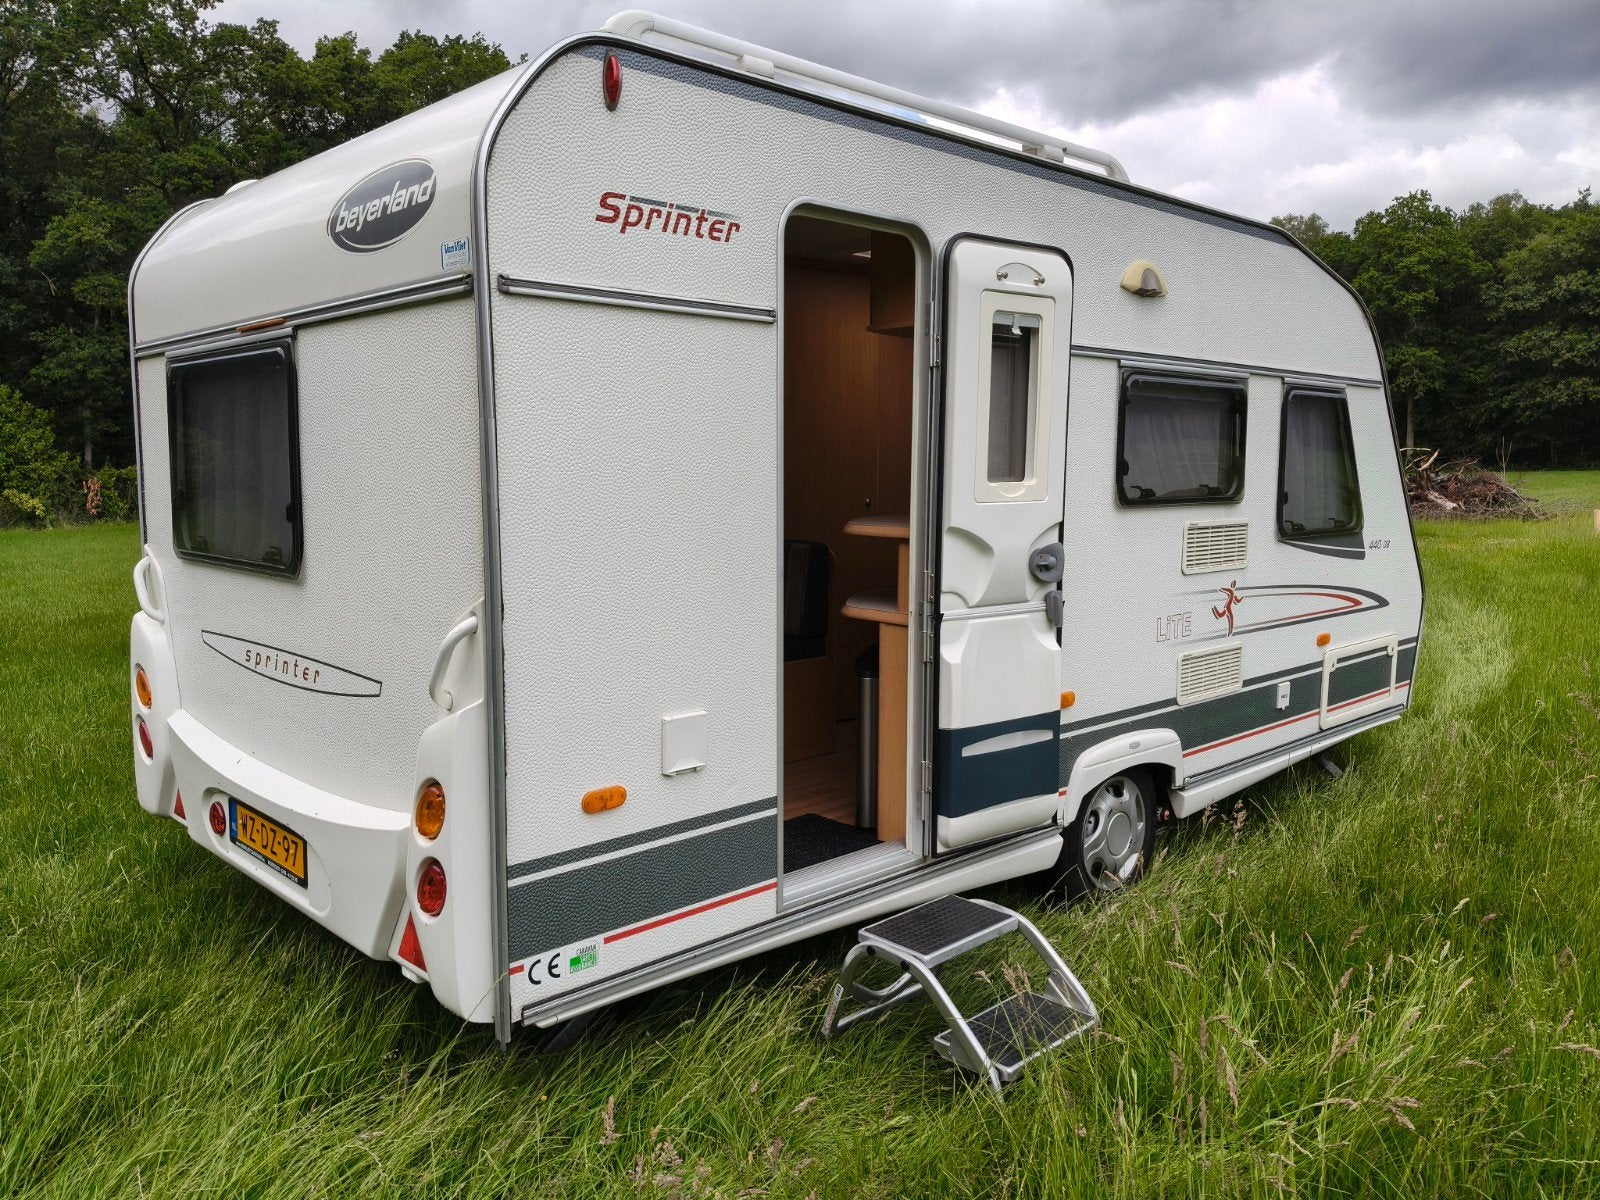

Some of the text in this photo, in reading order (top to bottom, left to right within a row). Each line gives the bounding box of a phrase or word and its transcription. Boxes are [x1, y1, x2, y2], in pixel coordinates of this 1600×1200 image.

[335, 172, 436, 233] beyerland
[595, 191, 741, 243] Sprinter
[245, 649, 320, 683] sprinter
[241, 811, 299, 867] WZ-DZ-97
